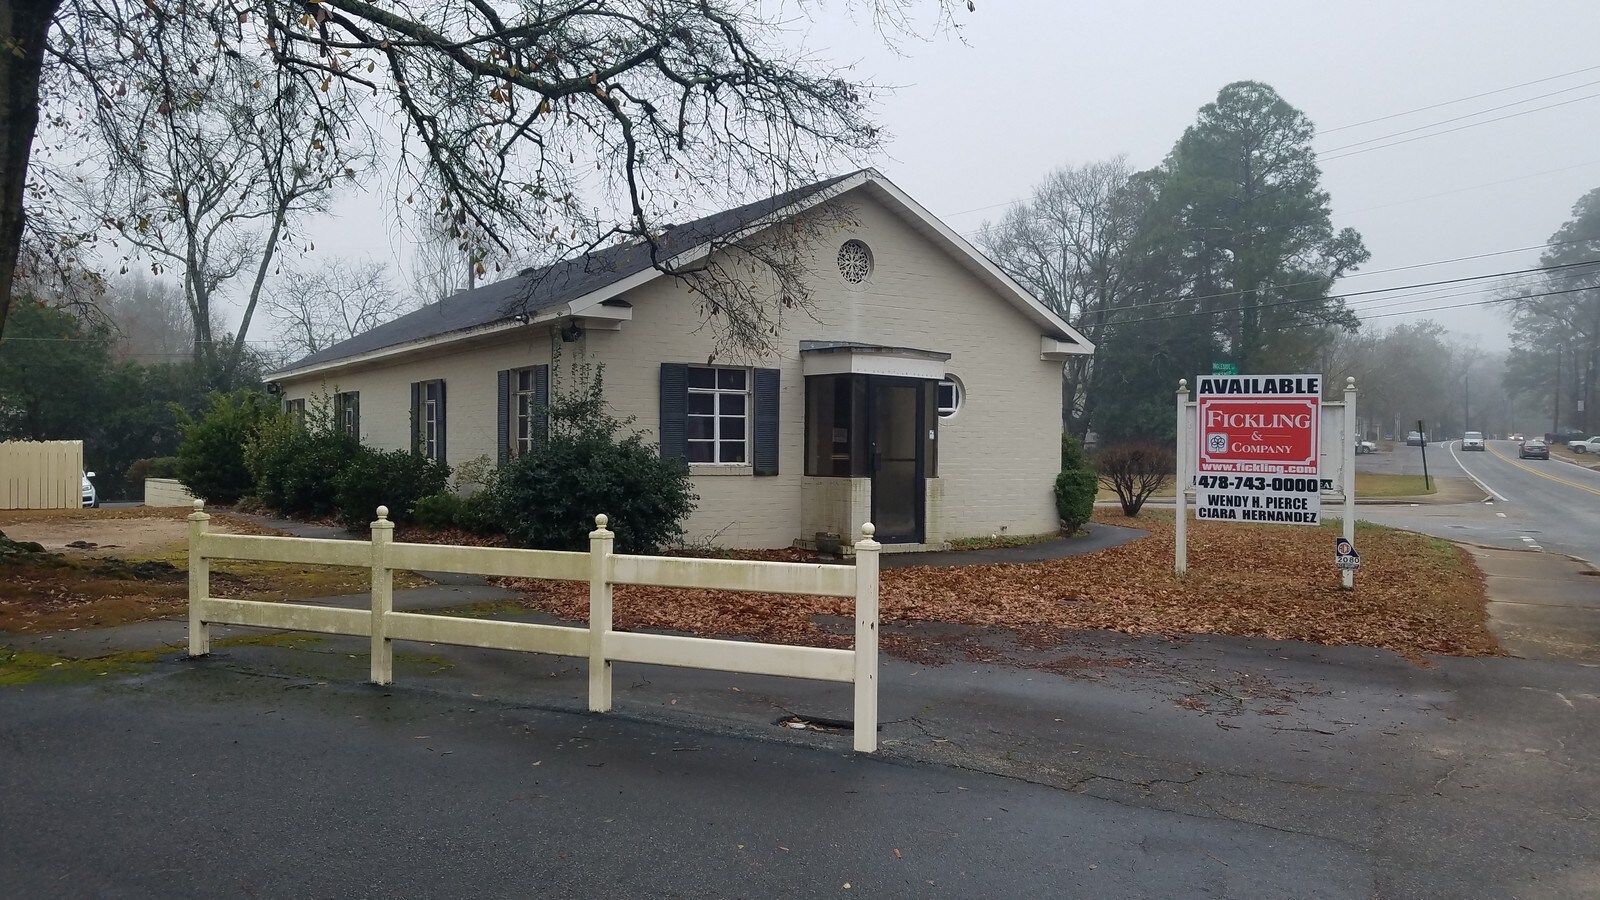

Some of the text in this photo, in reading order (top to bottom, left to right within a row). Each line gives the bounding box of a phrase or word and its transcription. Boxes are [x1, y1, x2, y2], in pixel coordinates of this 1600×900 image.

[1199, 378, 1319, 394] AVAILABLE
[1207, 410, 1311, 429] FICKLING
[1251, 430, 1263, 441] &
[1231, 442, 1293, 454] COMPANY
[1201, 462, 1317, 475] www.fickling.com
[1198, 475, 1319, 493] 478-743-0000
[1207, 494, 1308, 510] WENDY H. PIERCE
[1199, 507, 1317, 524] CIARA HERNANDEZ
